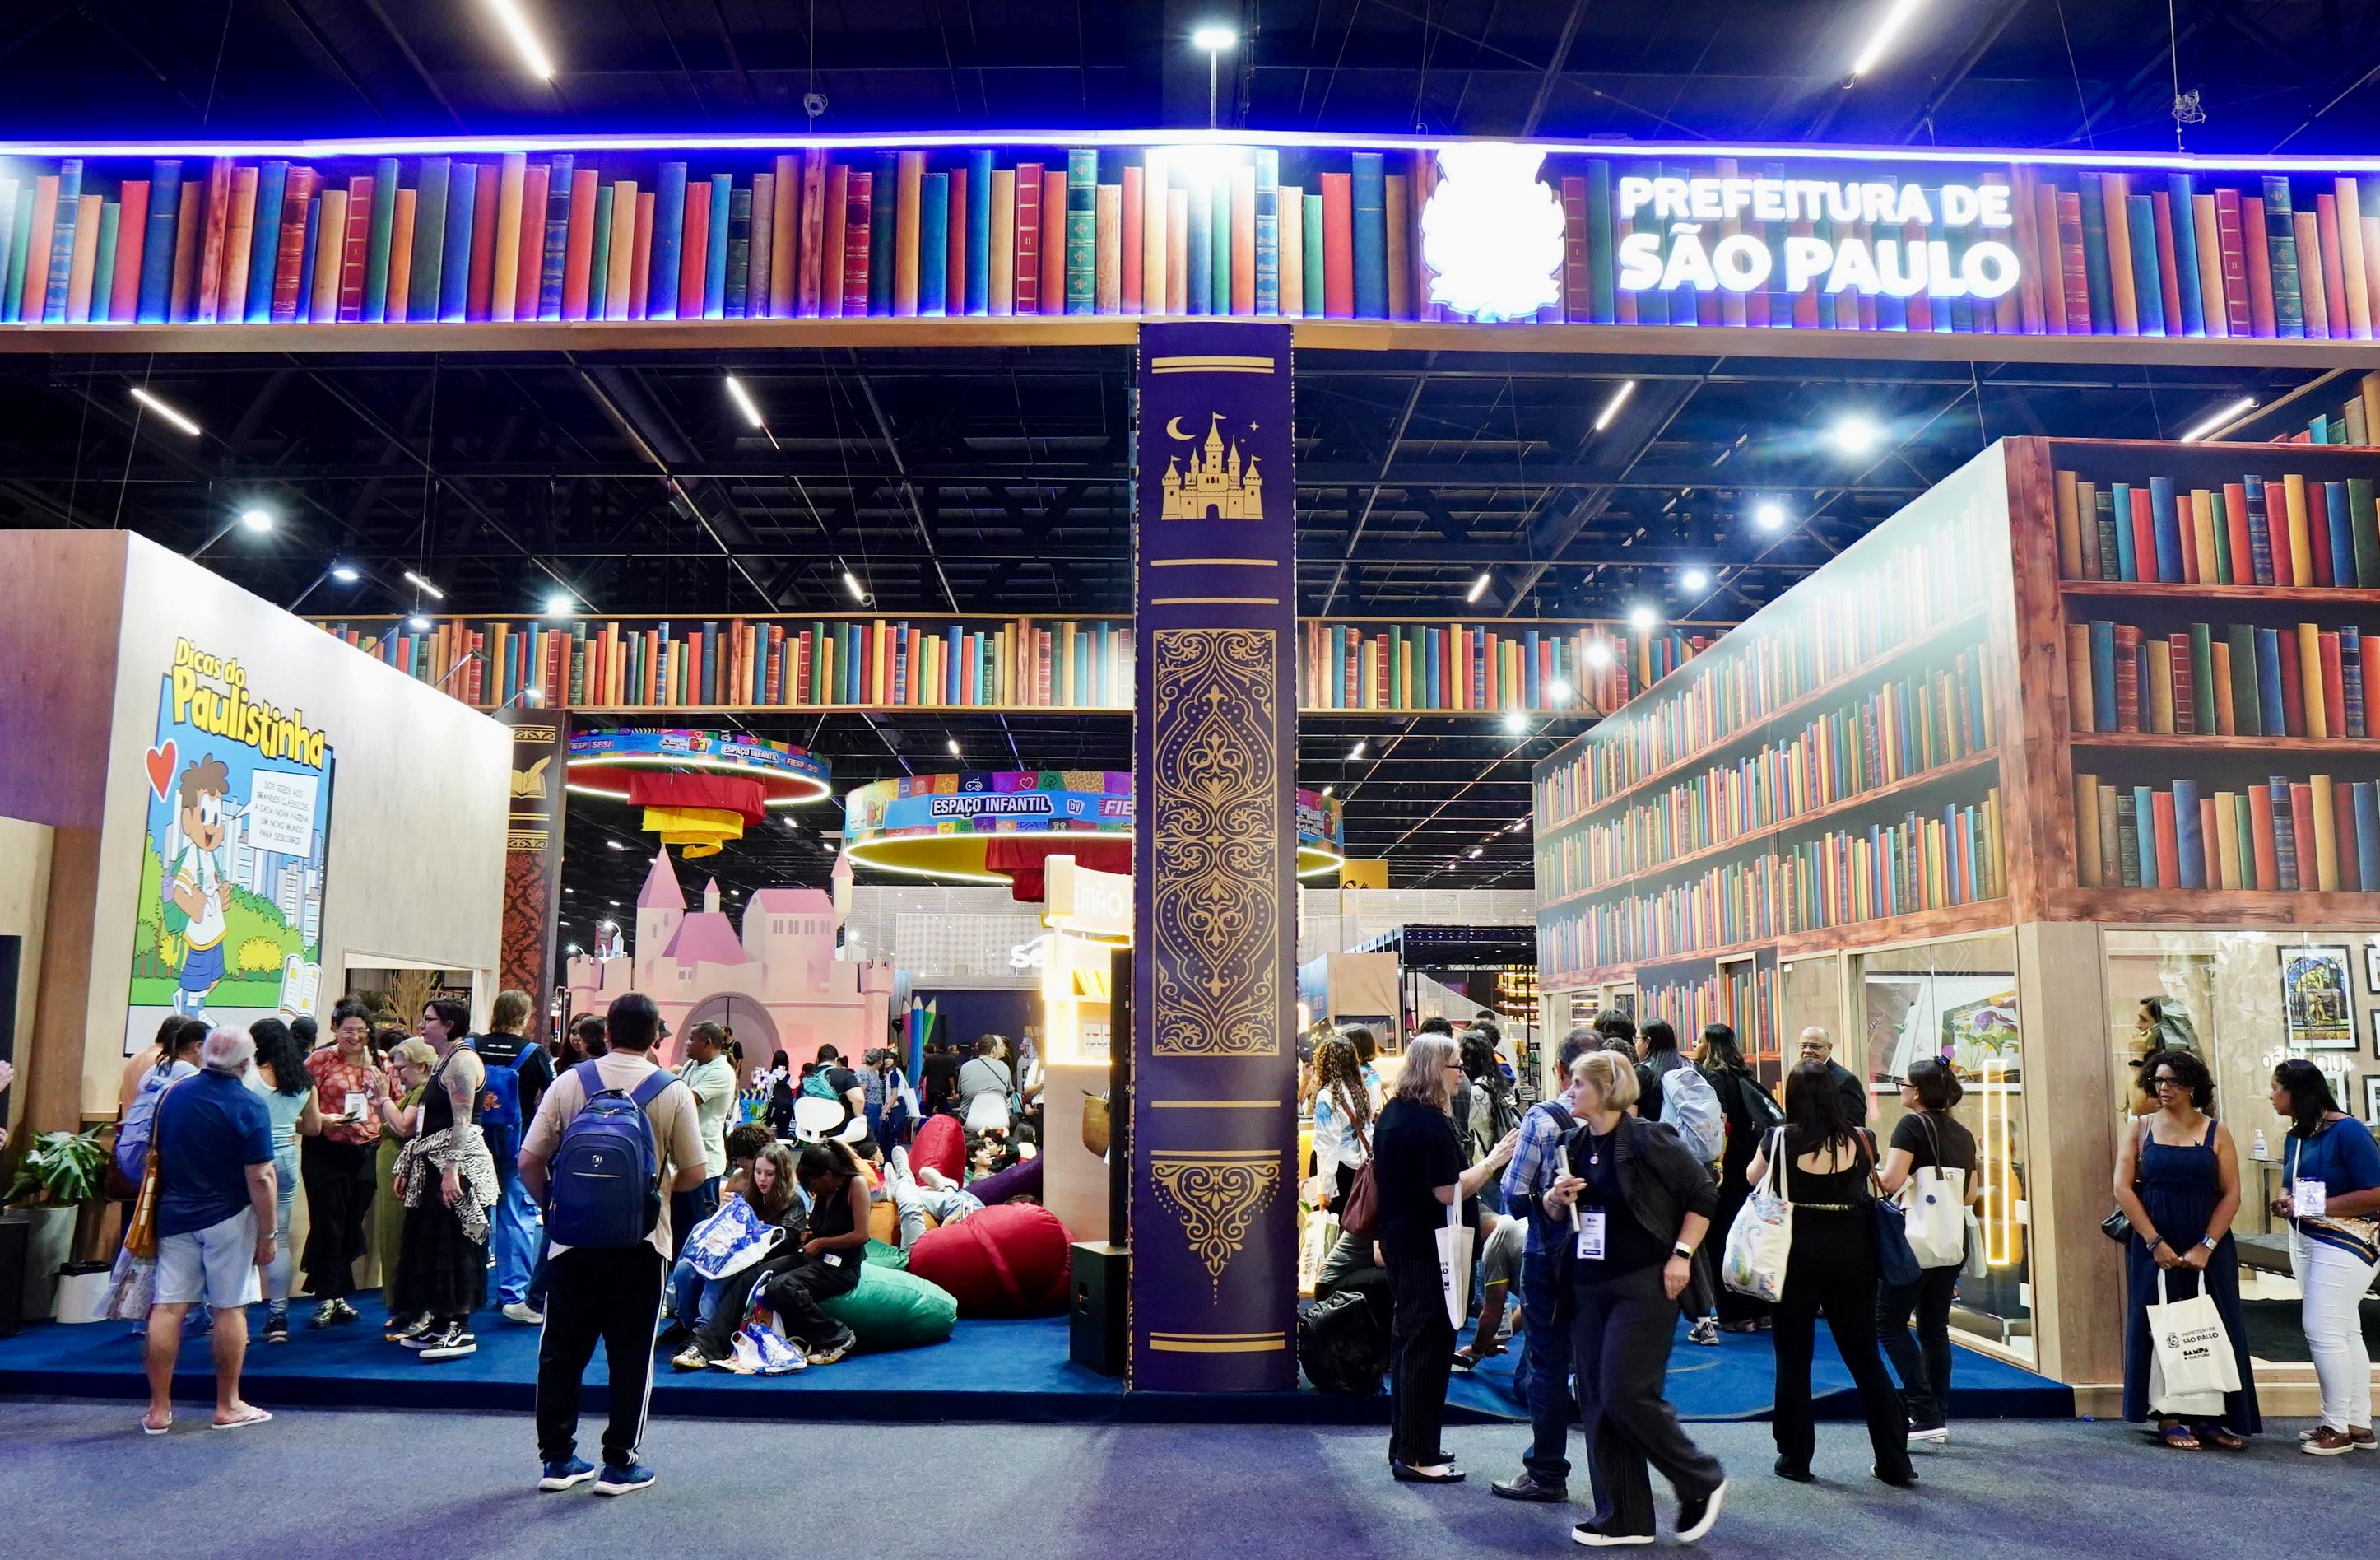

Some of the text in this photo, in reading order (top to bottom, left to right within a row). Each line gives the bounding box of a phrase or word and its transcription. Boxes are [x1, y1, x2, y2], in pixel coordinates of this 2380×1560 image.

[1619, 177, 2013, 230] PREFEITURA DE
[1619, 223, 2021, 299] SÃO PAULO
[174, 636, 246, 688] Dicas do
[171, 664, 326, 772] Paulistinha
[591, 740, 611, 749] SESI
[723, 745, 779, 761] ESPAÇO INFANTIL
[787, 757, 805, 768] FIESP
[933, 797, 1081, 816] ESPAÇO INFANTIL by
[1104, 800, 1132, 815] FIE
